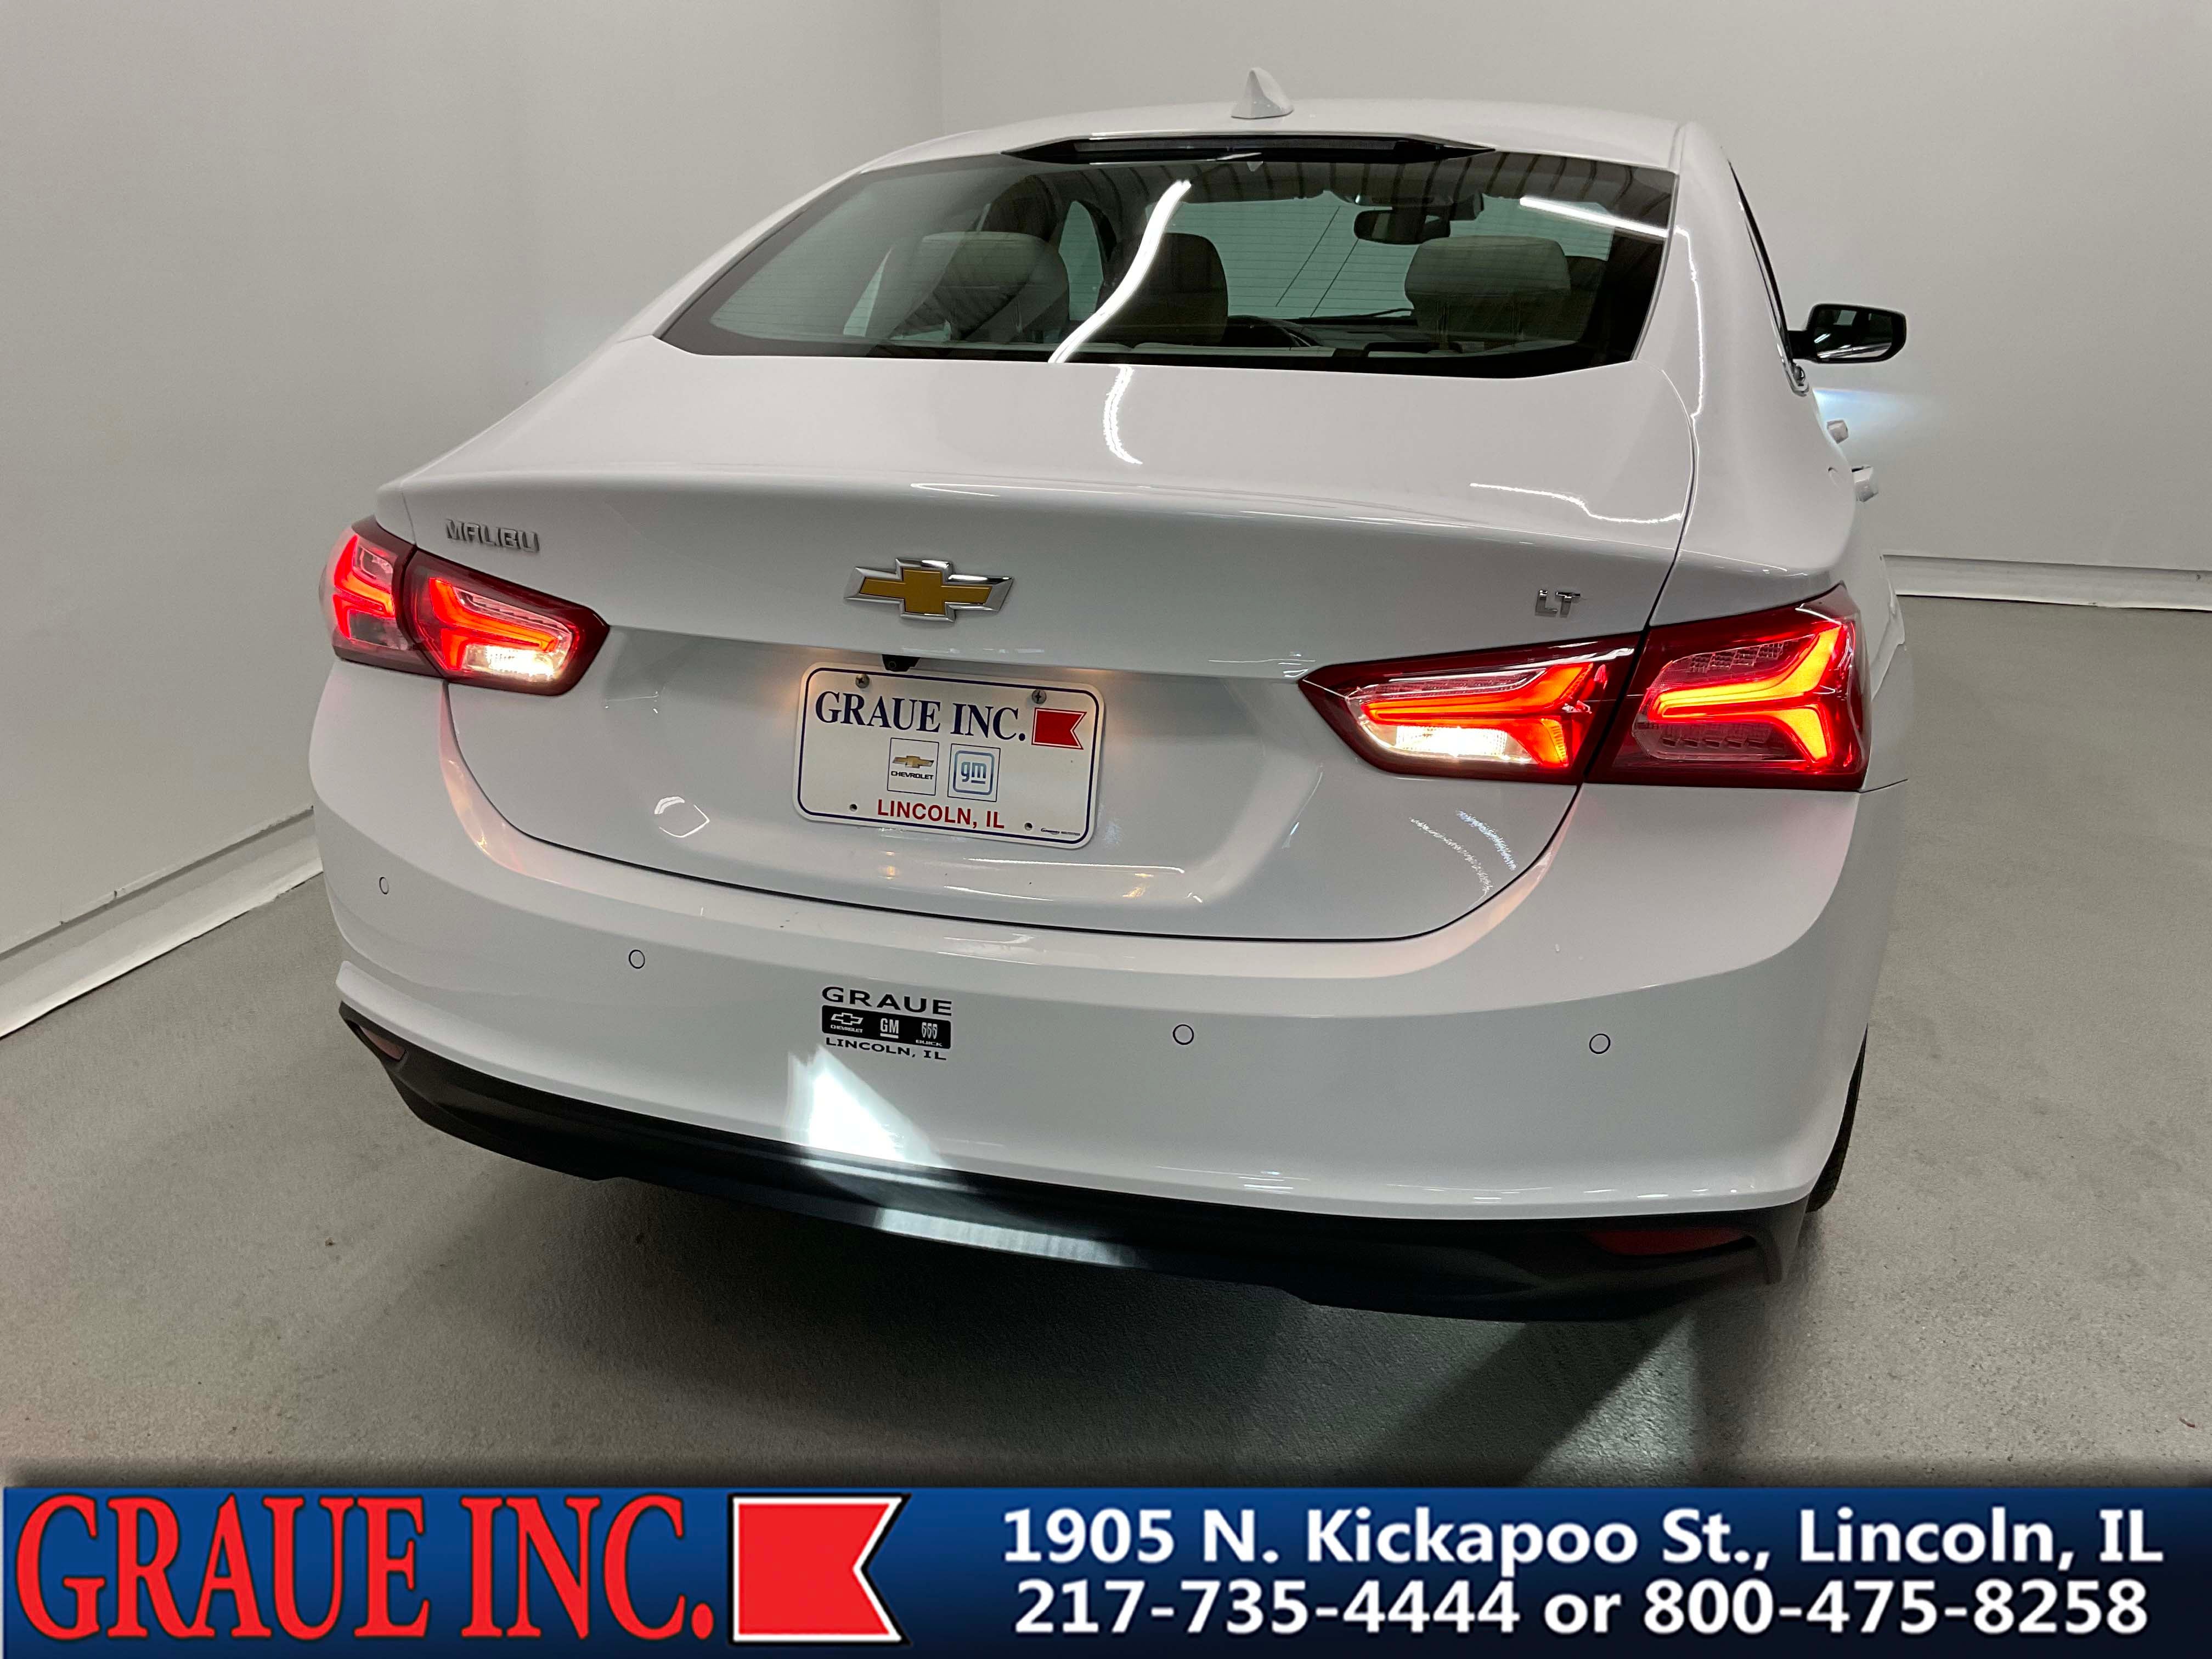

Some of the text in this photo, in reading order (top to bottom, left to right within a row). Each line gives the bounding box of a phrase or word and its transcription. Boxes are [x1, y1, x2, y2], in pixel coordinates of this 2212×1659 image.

[445, 518, 540, 553] MALIBU
[1535, 590, 1581, 618] LT
[815, 691, 1026, 741] GRAUE INC.
[891, 771, 934, 780] CHEVROLET
[961, 761, 986, 782] gm
[877, 799, 1005, 829] LINCOLN, IL
[822, 986, 952, 1016] GRAUE
[830, 1024, 863, 1033] CHEVROLET
[880, 1018, 899, 1034] GM
[826, 1037, 946, 1060] LINCOLN, IL
